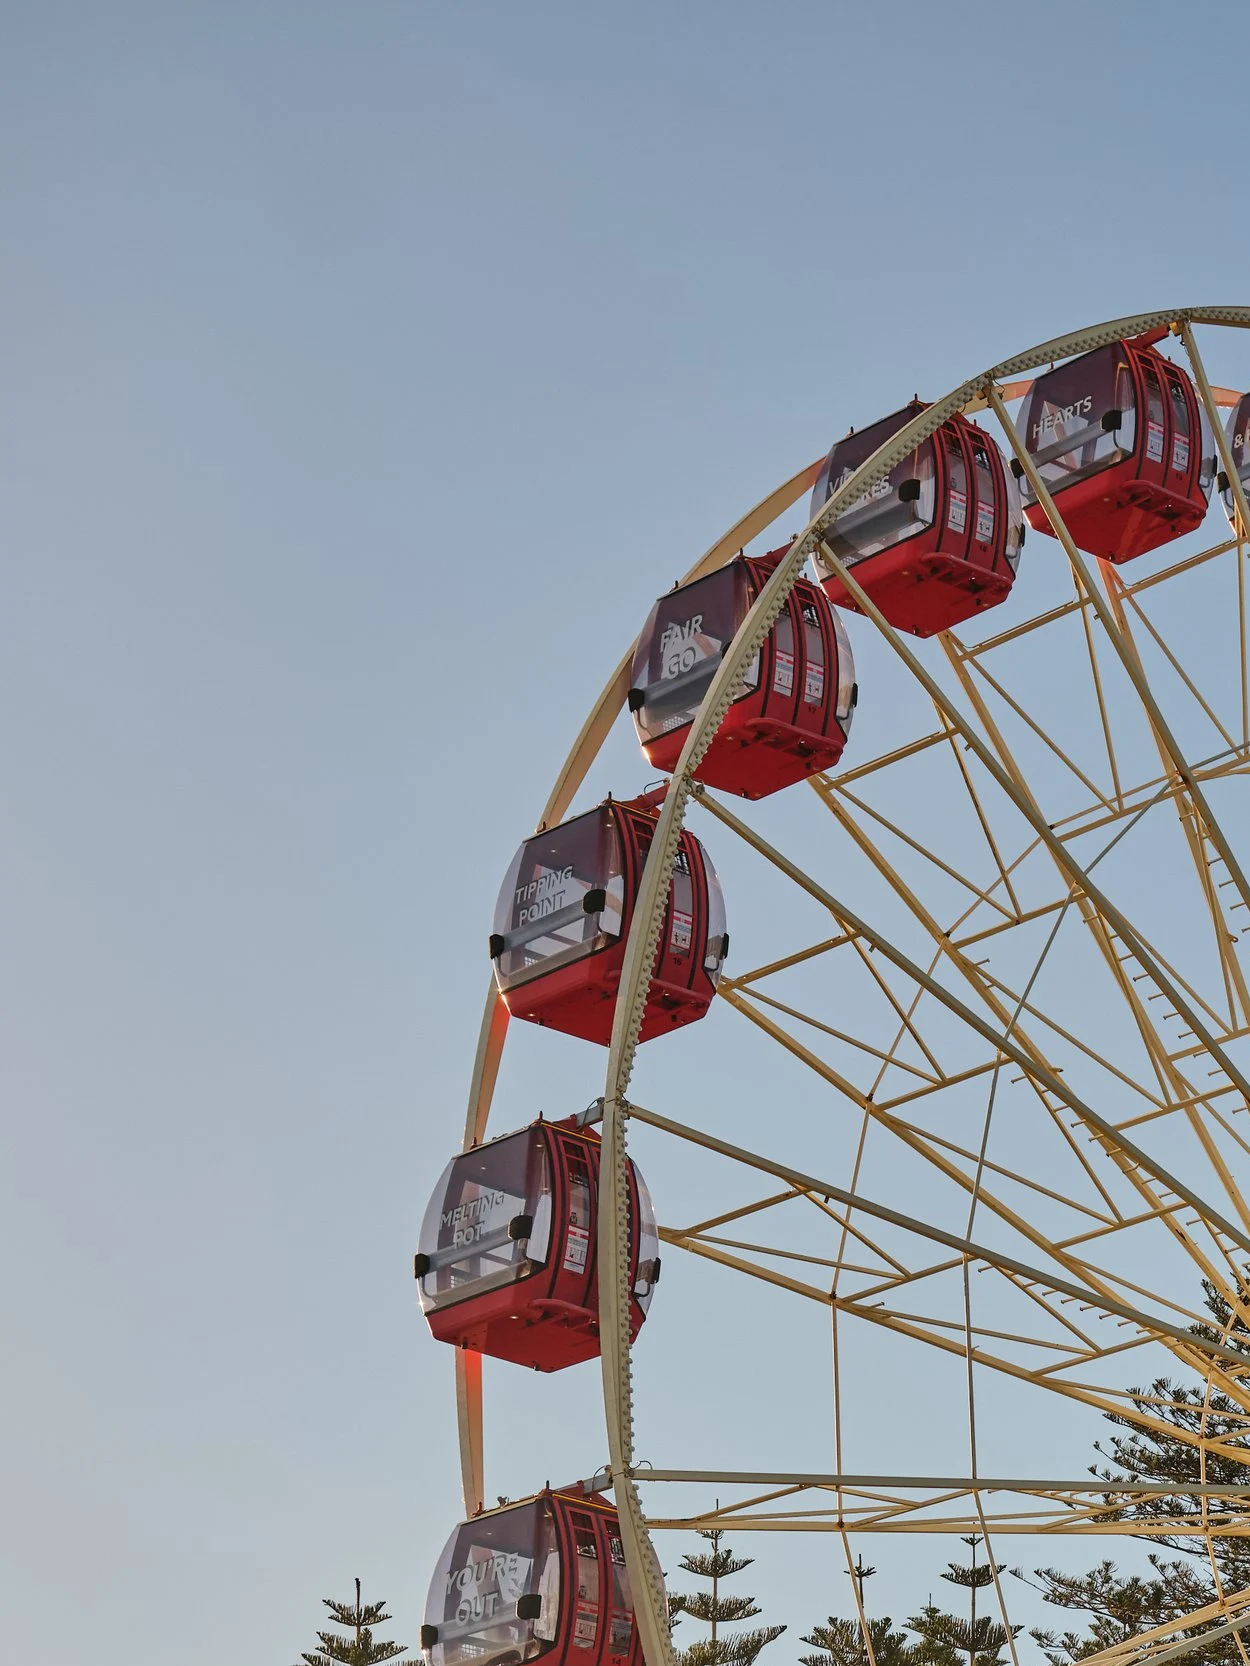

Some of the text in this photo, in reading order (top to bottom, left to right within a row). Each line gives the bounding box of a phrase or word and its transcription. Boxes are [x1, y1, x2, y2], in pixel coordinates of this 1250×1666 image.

[1032, 395, 1092, 439] HEARTS
[1233, 433, 1244, 448] &
[660, 614, 703, 653] FAIR
[667, 647, 695, 679] GO
[515, 866, 573, 904] TIPPING
[519, 891, 566, 926] POINT
[440, 1190, 505, 1231] MELTING
[453, 1222, 485, 1249] POT
[455, 1592, 499, 1627] OUT
